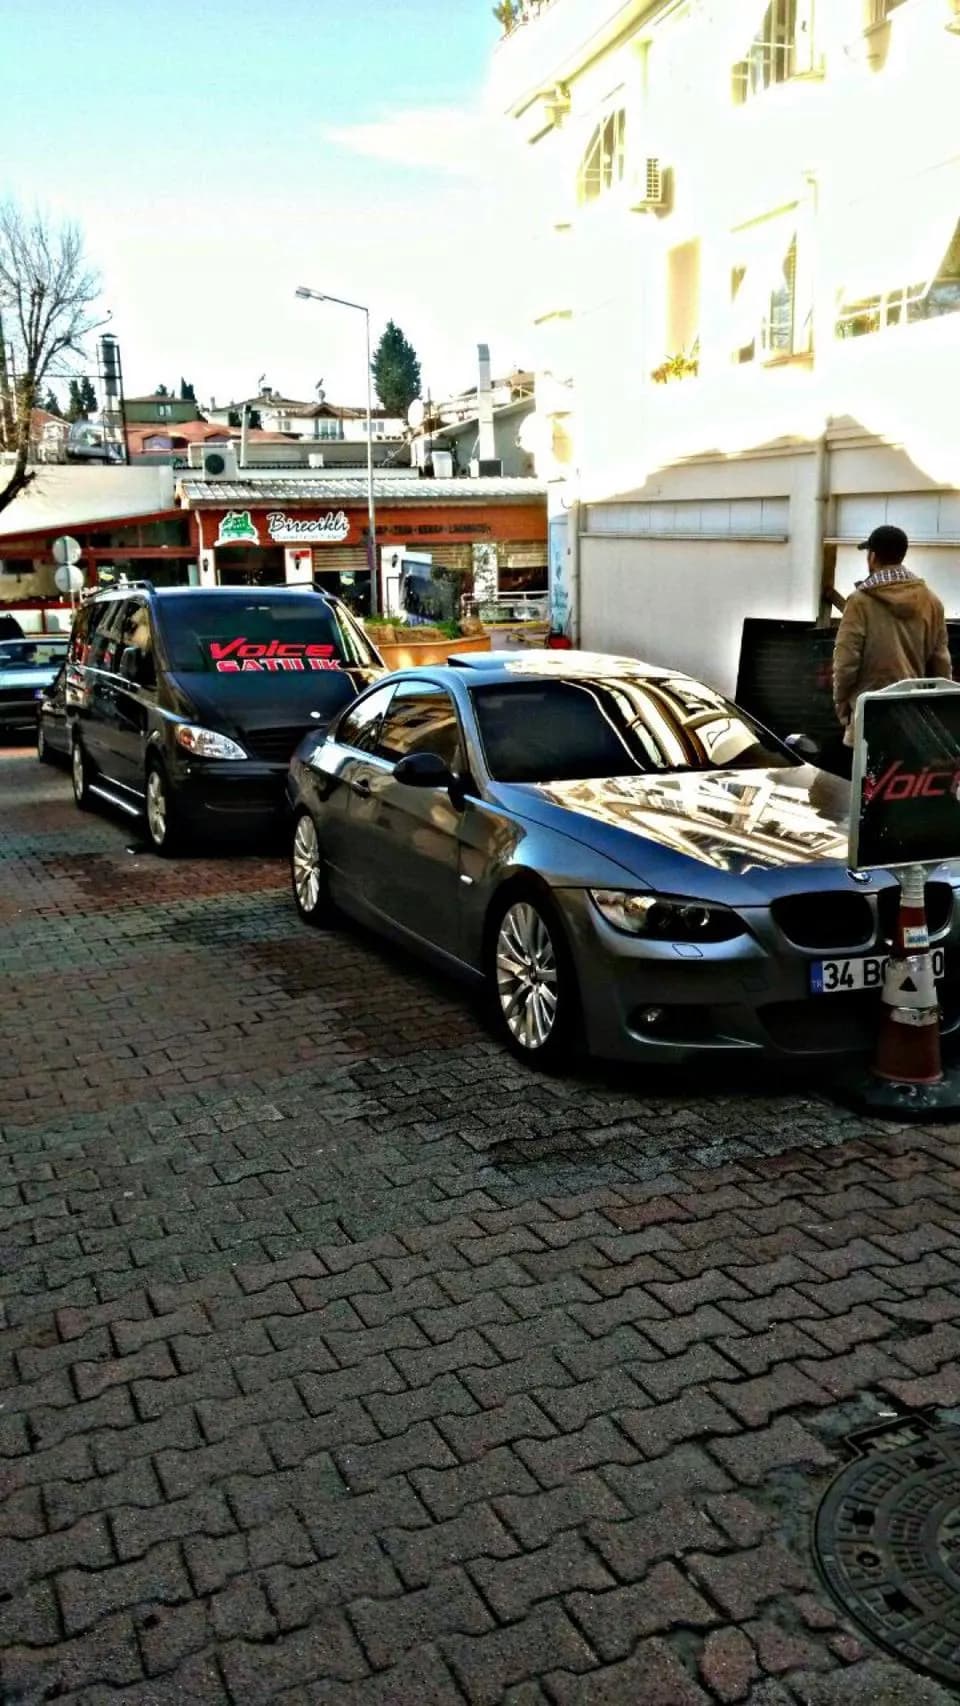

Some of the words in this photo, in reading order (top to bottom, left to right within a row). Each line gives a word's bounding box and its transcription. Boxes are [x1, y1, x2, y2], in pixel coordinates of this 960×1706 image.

[268, 512, 348, 533] Birecikli
[210, 636, 335, 659] Voice
[824, 961, 854, 989] 34
